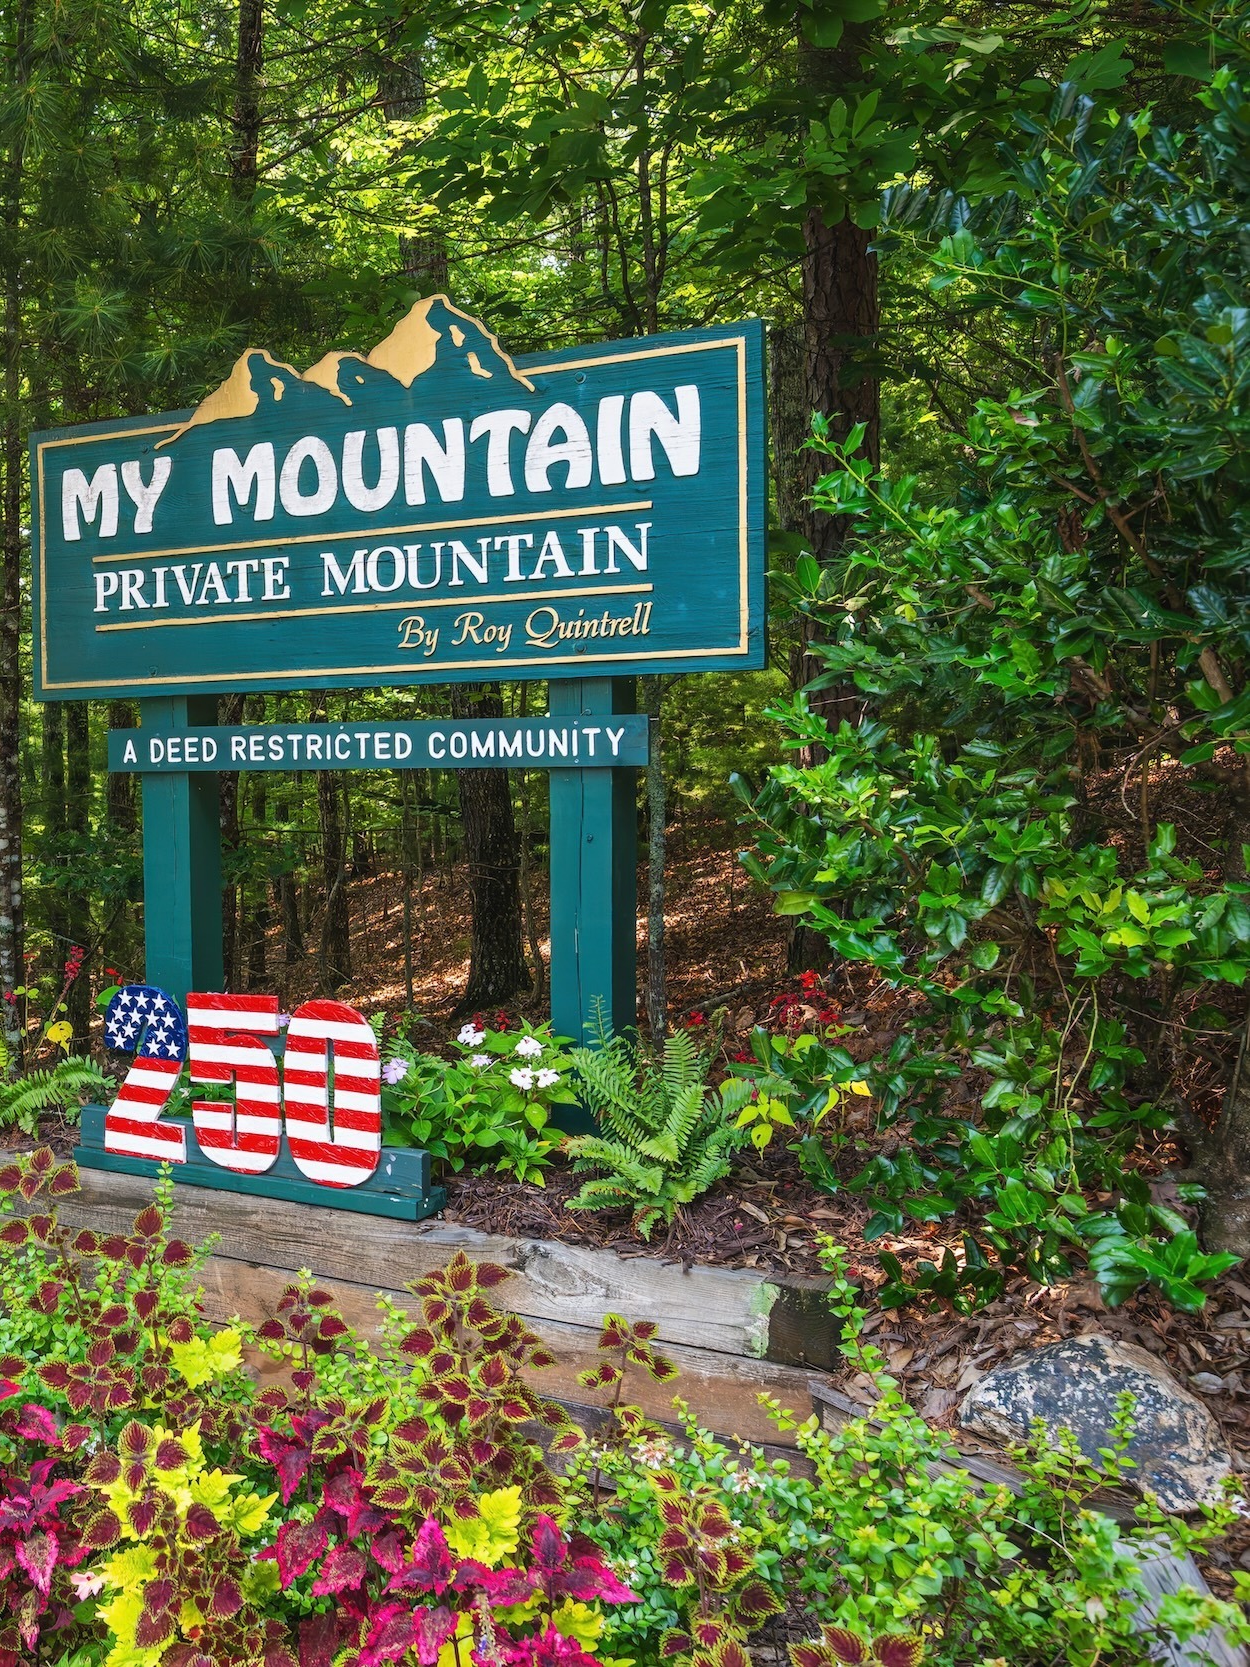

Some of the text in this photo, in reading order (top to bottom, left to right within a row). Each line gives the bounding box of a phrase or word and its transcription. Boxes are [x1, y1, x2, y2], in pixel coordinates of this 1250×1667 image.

[62, 384, 701, 541] MY MOUNTAIN
[93, 523, 653, 613] PRIVATE MOUNTAIN
[398, 602, 652, 655] By Roy Quintrell
[123, 727, 625, 764] A DEED RESTRICTED COMMUNITY
[103, 985, 381, 1189] 250
